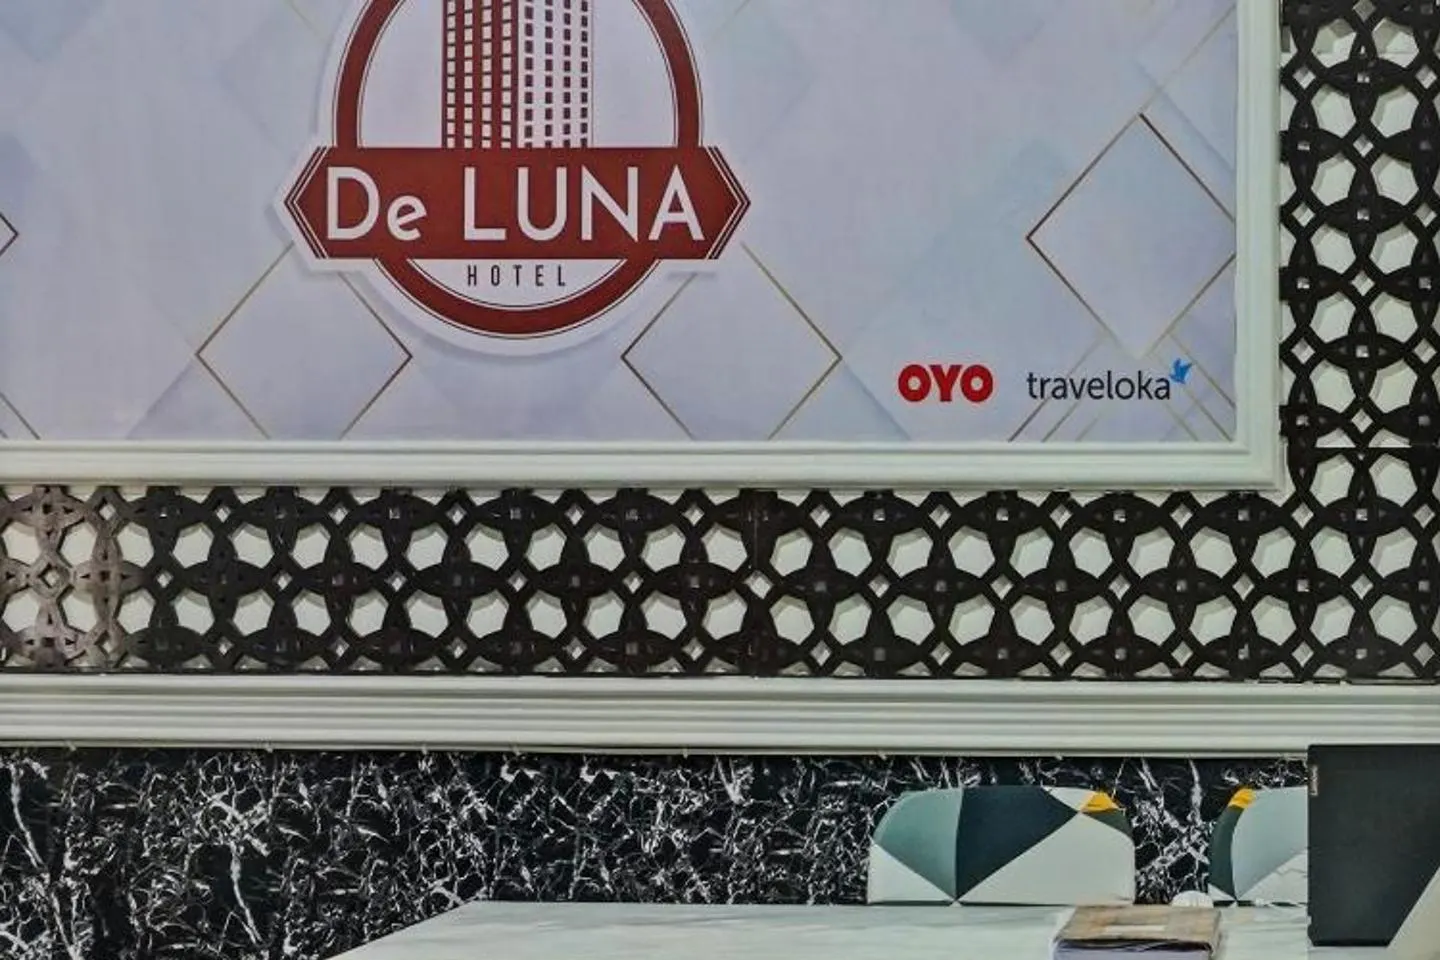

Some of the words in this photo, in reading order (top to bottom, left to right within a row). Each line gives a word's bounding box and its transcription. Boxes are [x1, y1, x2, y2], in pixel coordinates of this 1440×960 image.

[326, 165, 428, 241] De
[463, 164, 706, 242] LUNA
[466, 264, 567, 287] HOTEL
[898, 363, 994, 403] OYO
[1026, 370, 1171, 401] traveloka
